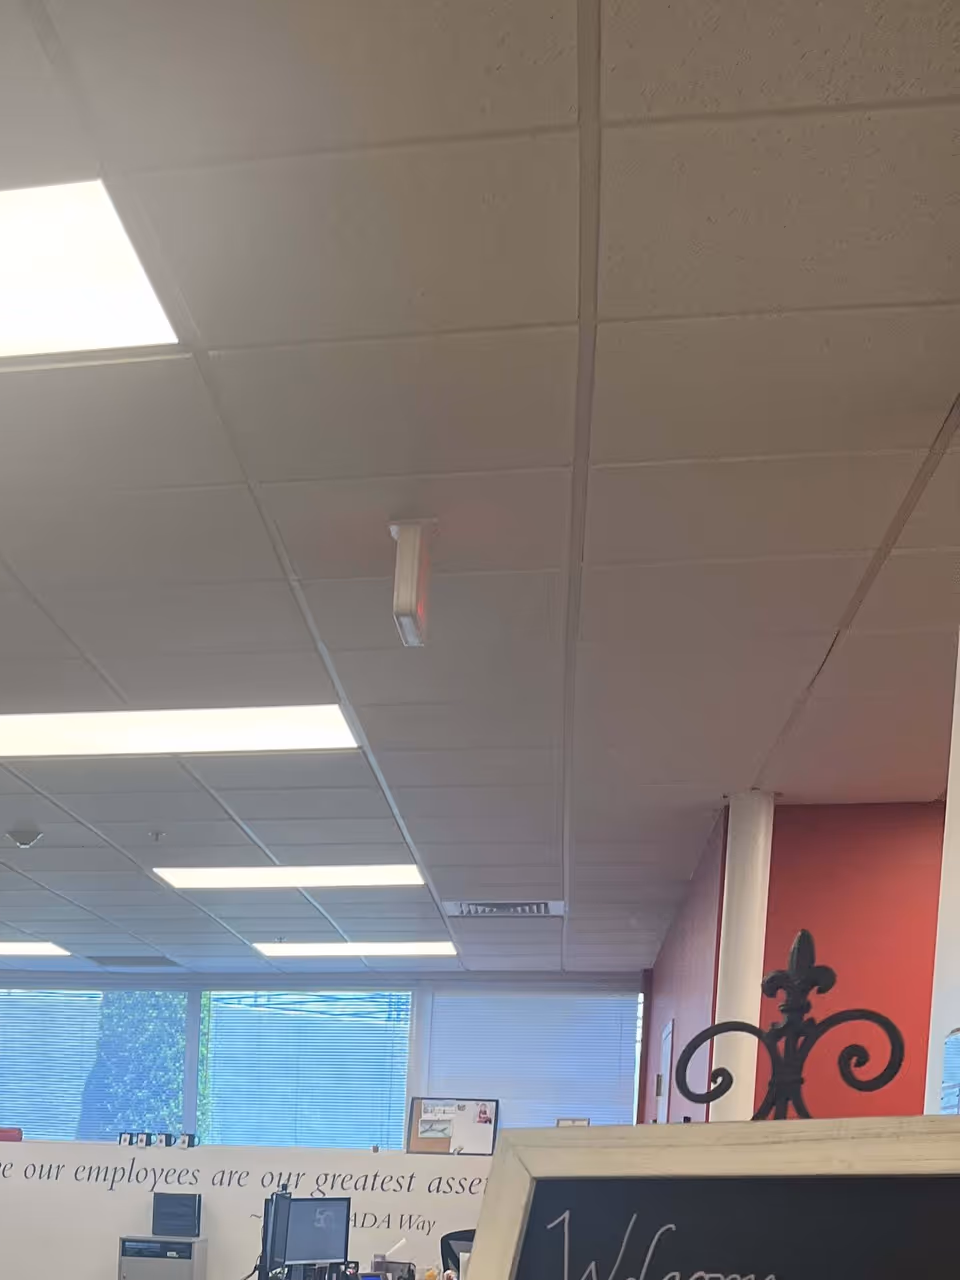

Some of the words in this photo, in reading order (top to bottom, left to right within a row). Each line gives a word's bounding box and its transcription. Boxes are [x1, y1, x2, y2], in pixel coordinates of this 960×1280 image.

[23, 1162, 65, 1181] our
[74, 1156, 200, 1192] employees
[211, 1168, 249, 1188] are
[261, 1169, 305, 1189] our
[310, 1169, 416, 1198] greatest
[399, 1213, 436, 1236] Way
